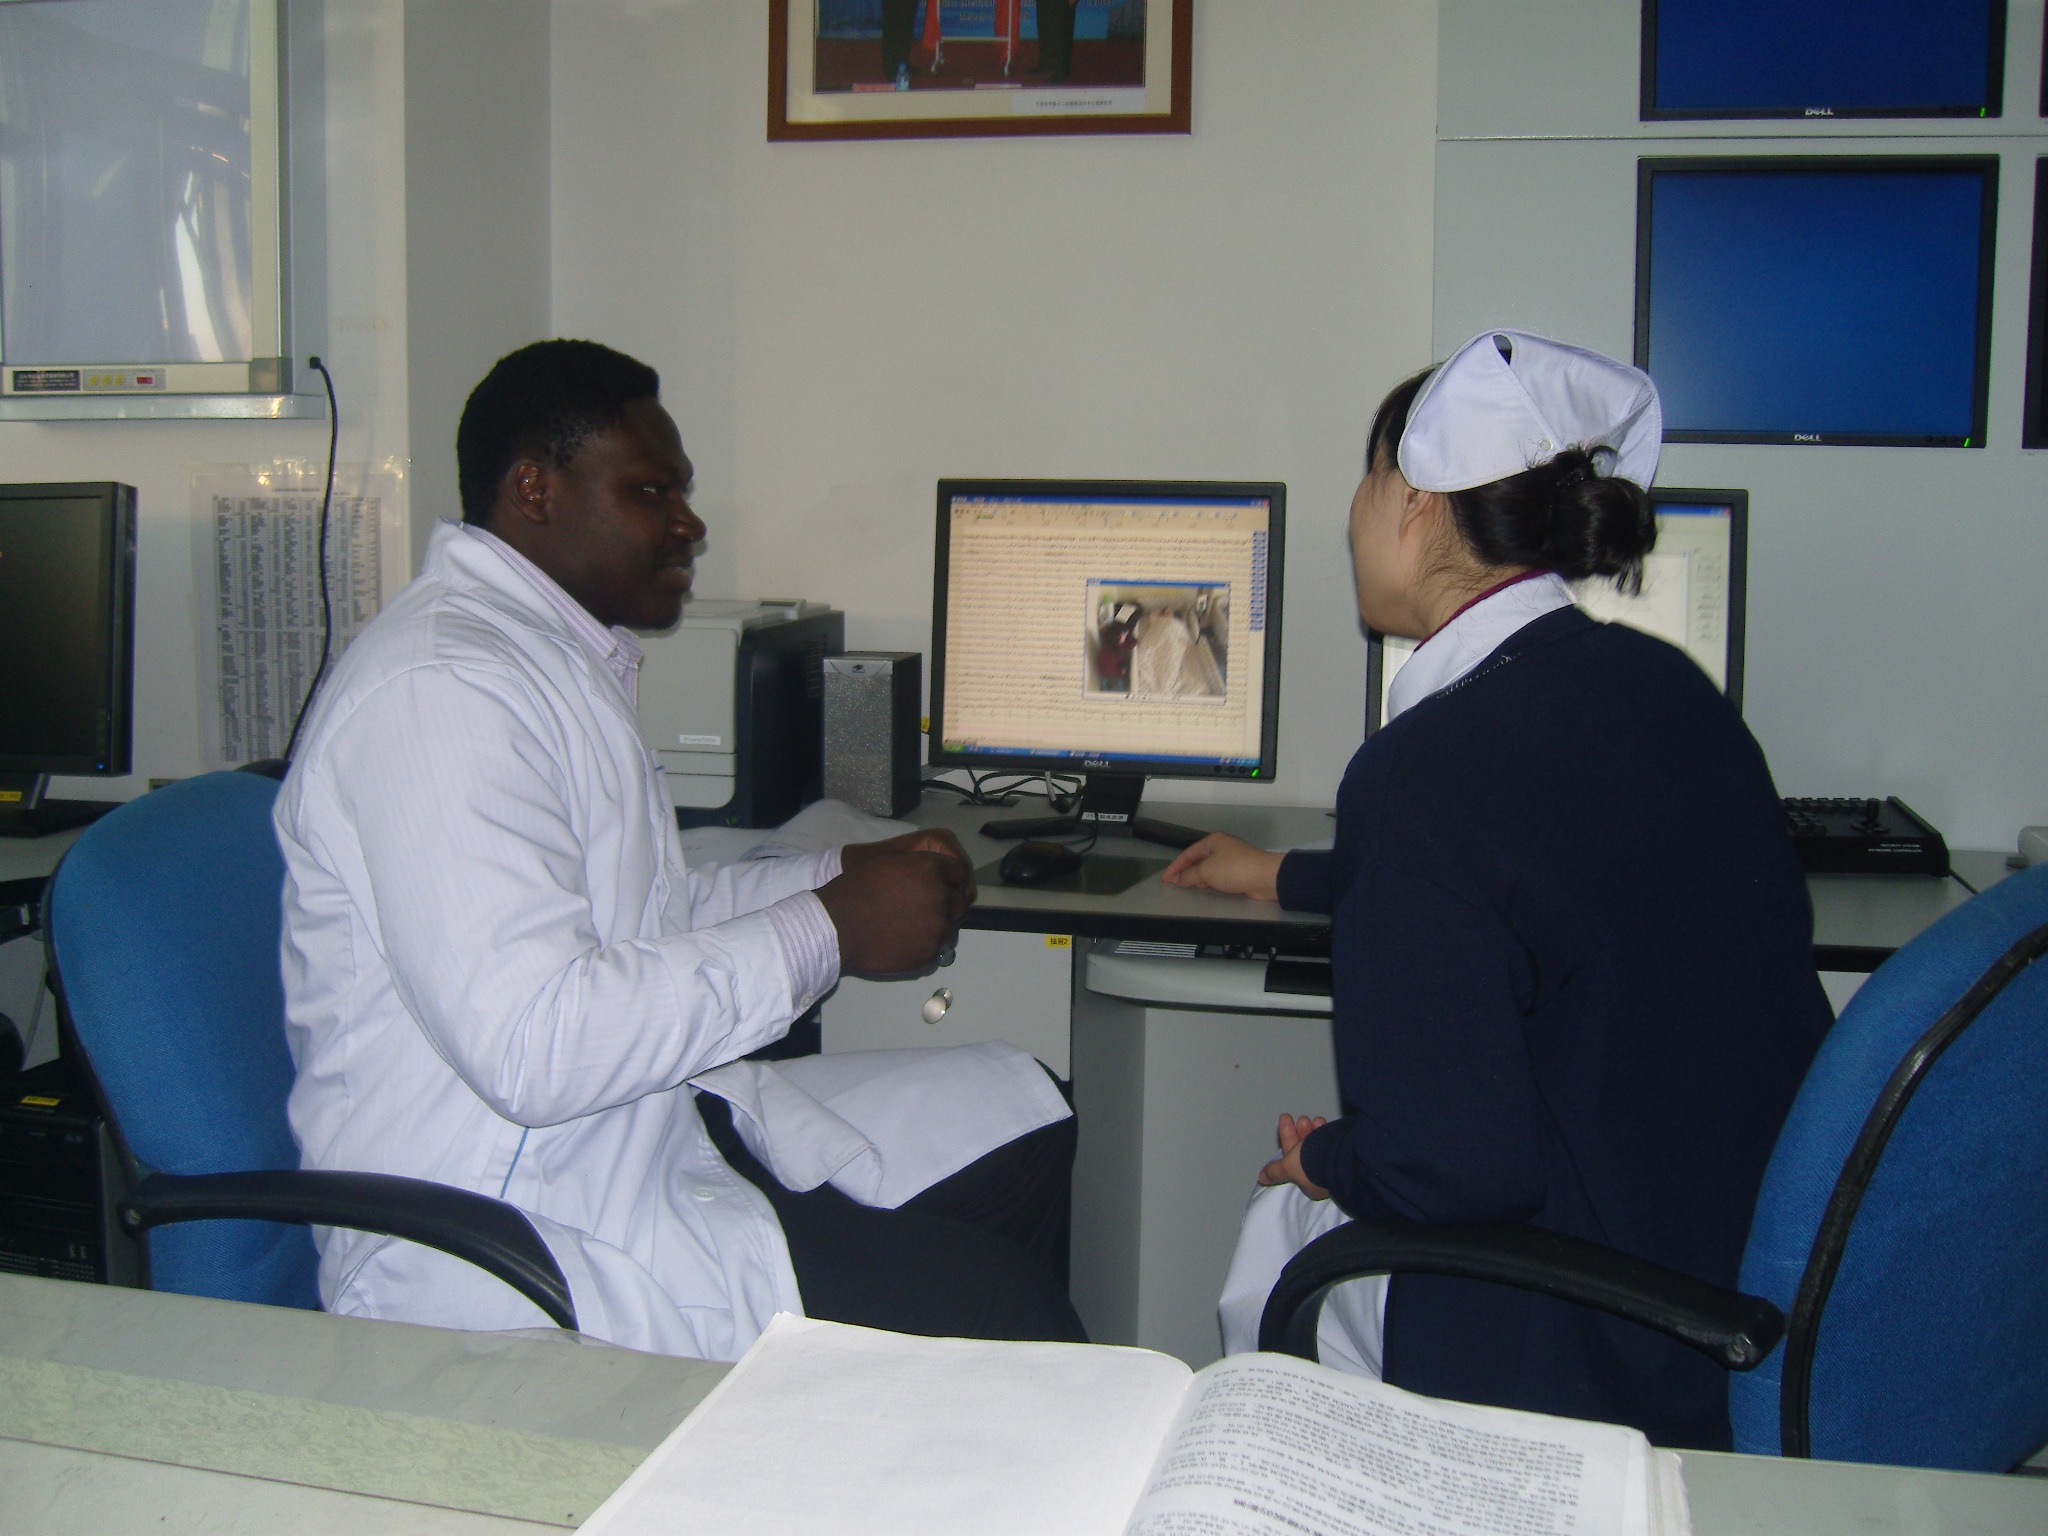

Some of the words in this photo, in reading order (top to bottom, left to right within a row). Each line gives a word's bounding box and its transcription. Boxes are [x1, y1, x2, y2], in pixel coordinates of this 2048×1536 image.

[1805, 107, 1834, 116] DELL
[1794, 433, 1822, 442] DELL
[1084, 759, 1111, 768] DELL
